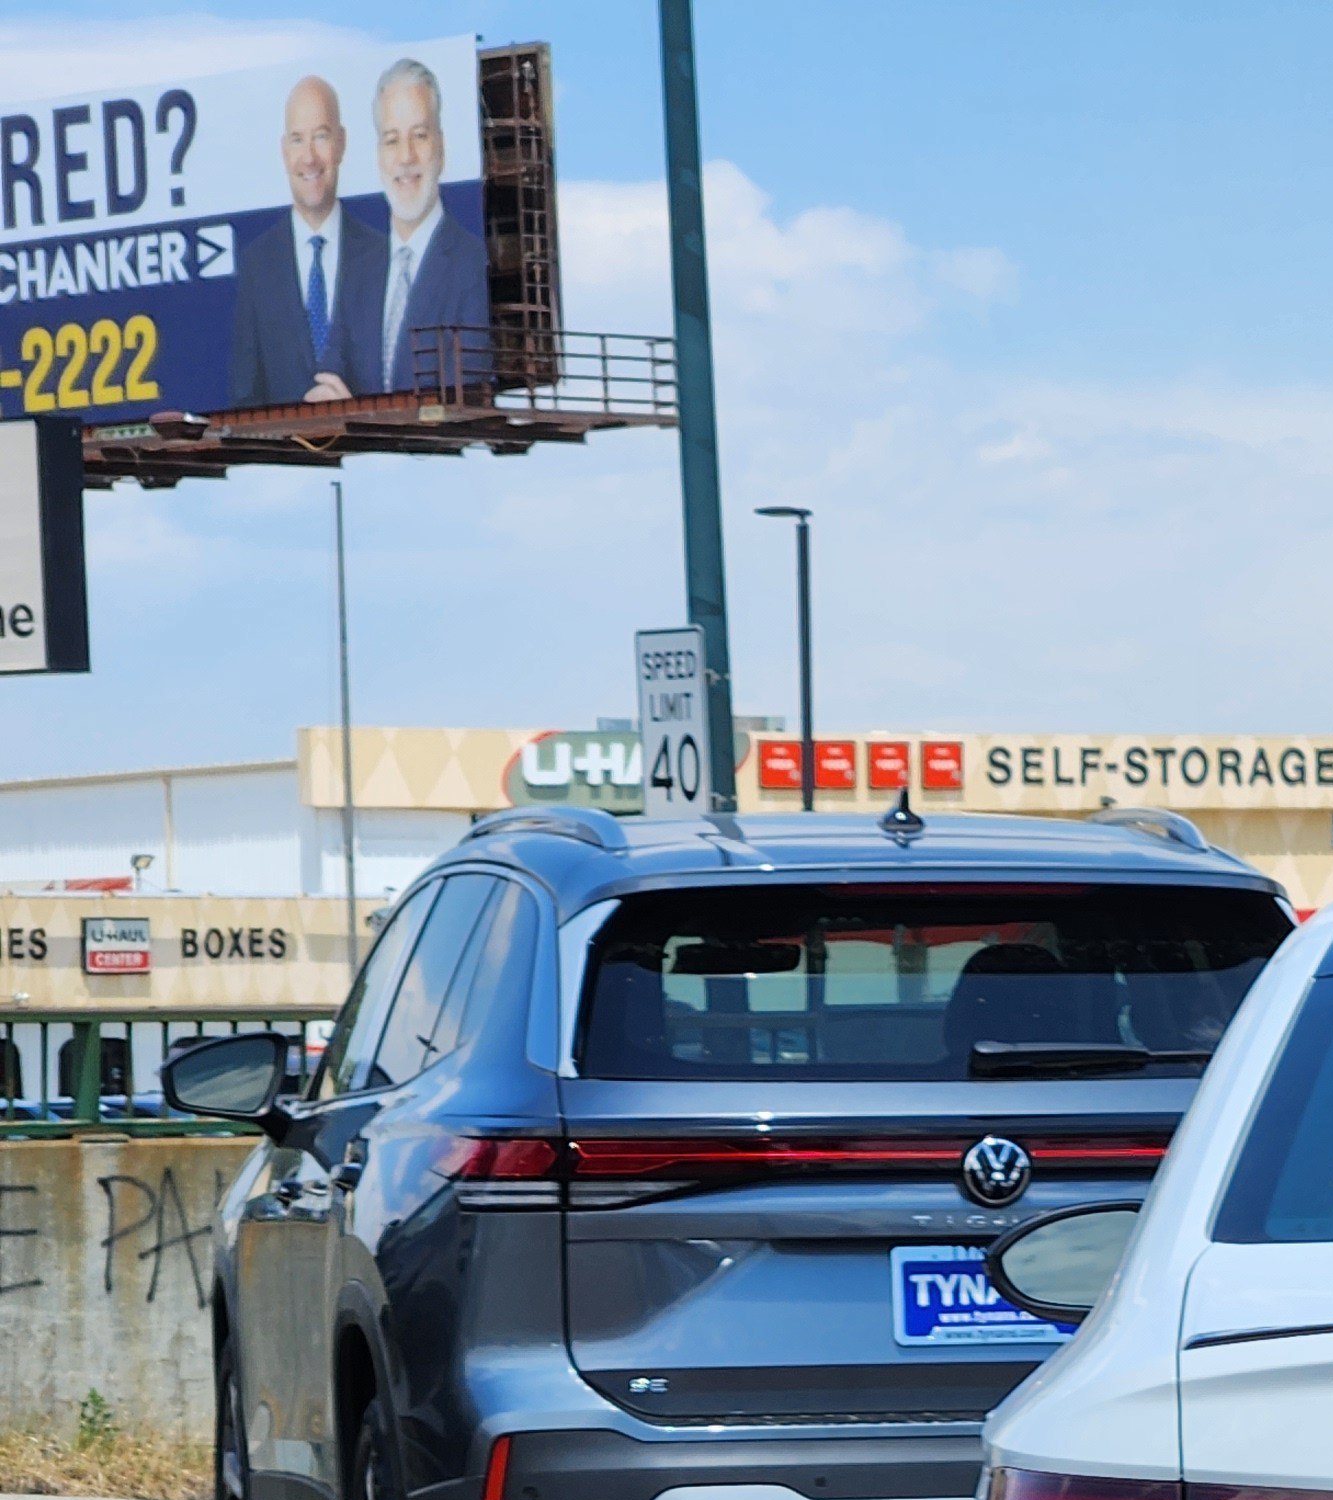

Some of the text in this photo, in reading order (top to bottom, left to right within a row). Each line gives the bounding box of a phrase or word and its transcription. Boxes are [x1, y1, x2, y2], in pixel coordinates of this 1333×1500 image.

[643, 651, 694, 680] SPEED
[649, 692, 692, 721] LIMIT
[651, 733, 699, 802] 40
[0, 928, 47, 960] ES
[181, 928, 287, 959] BOXES
